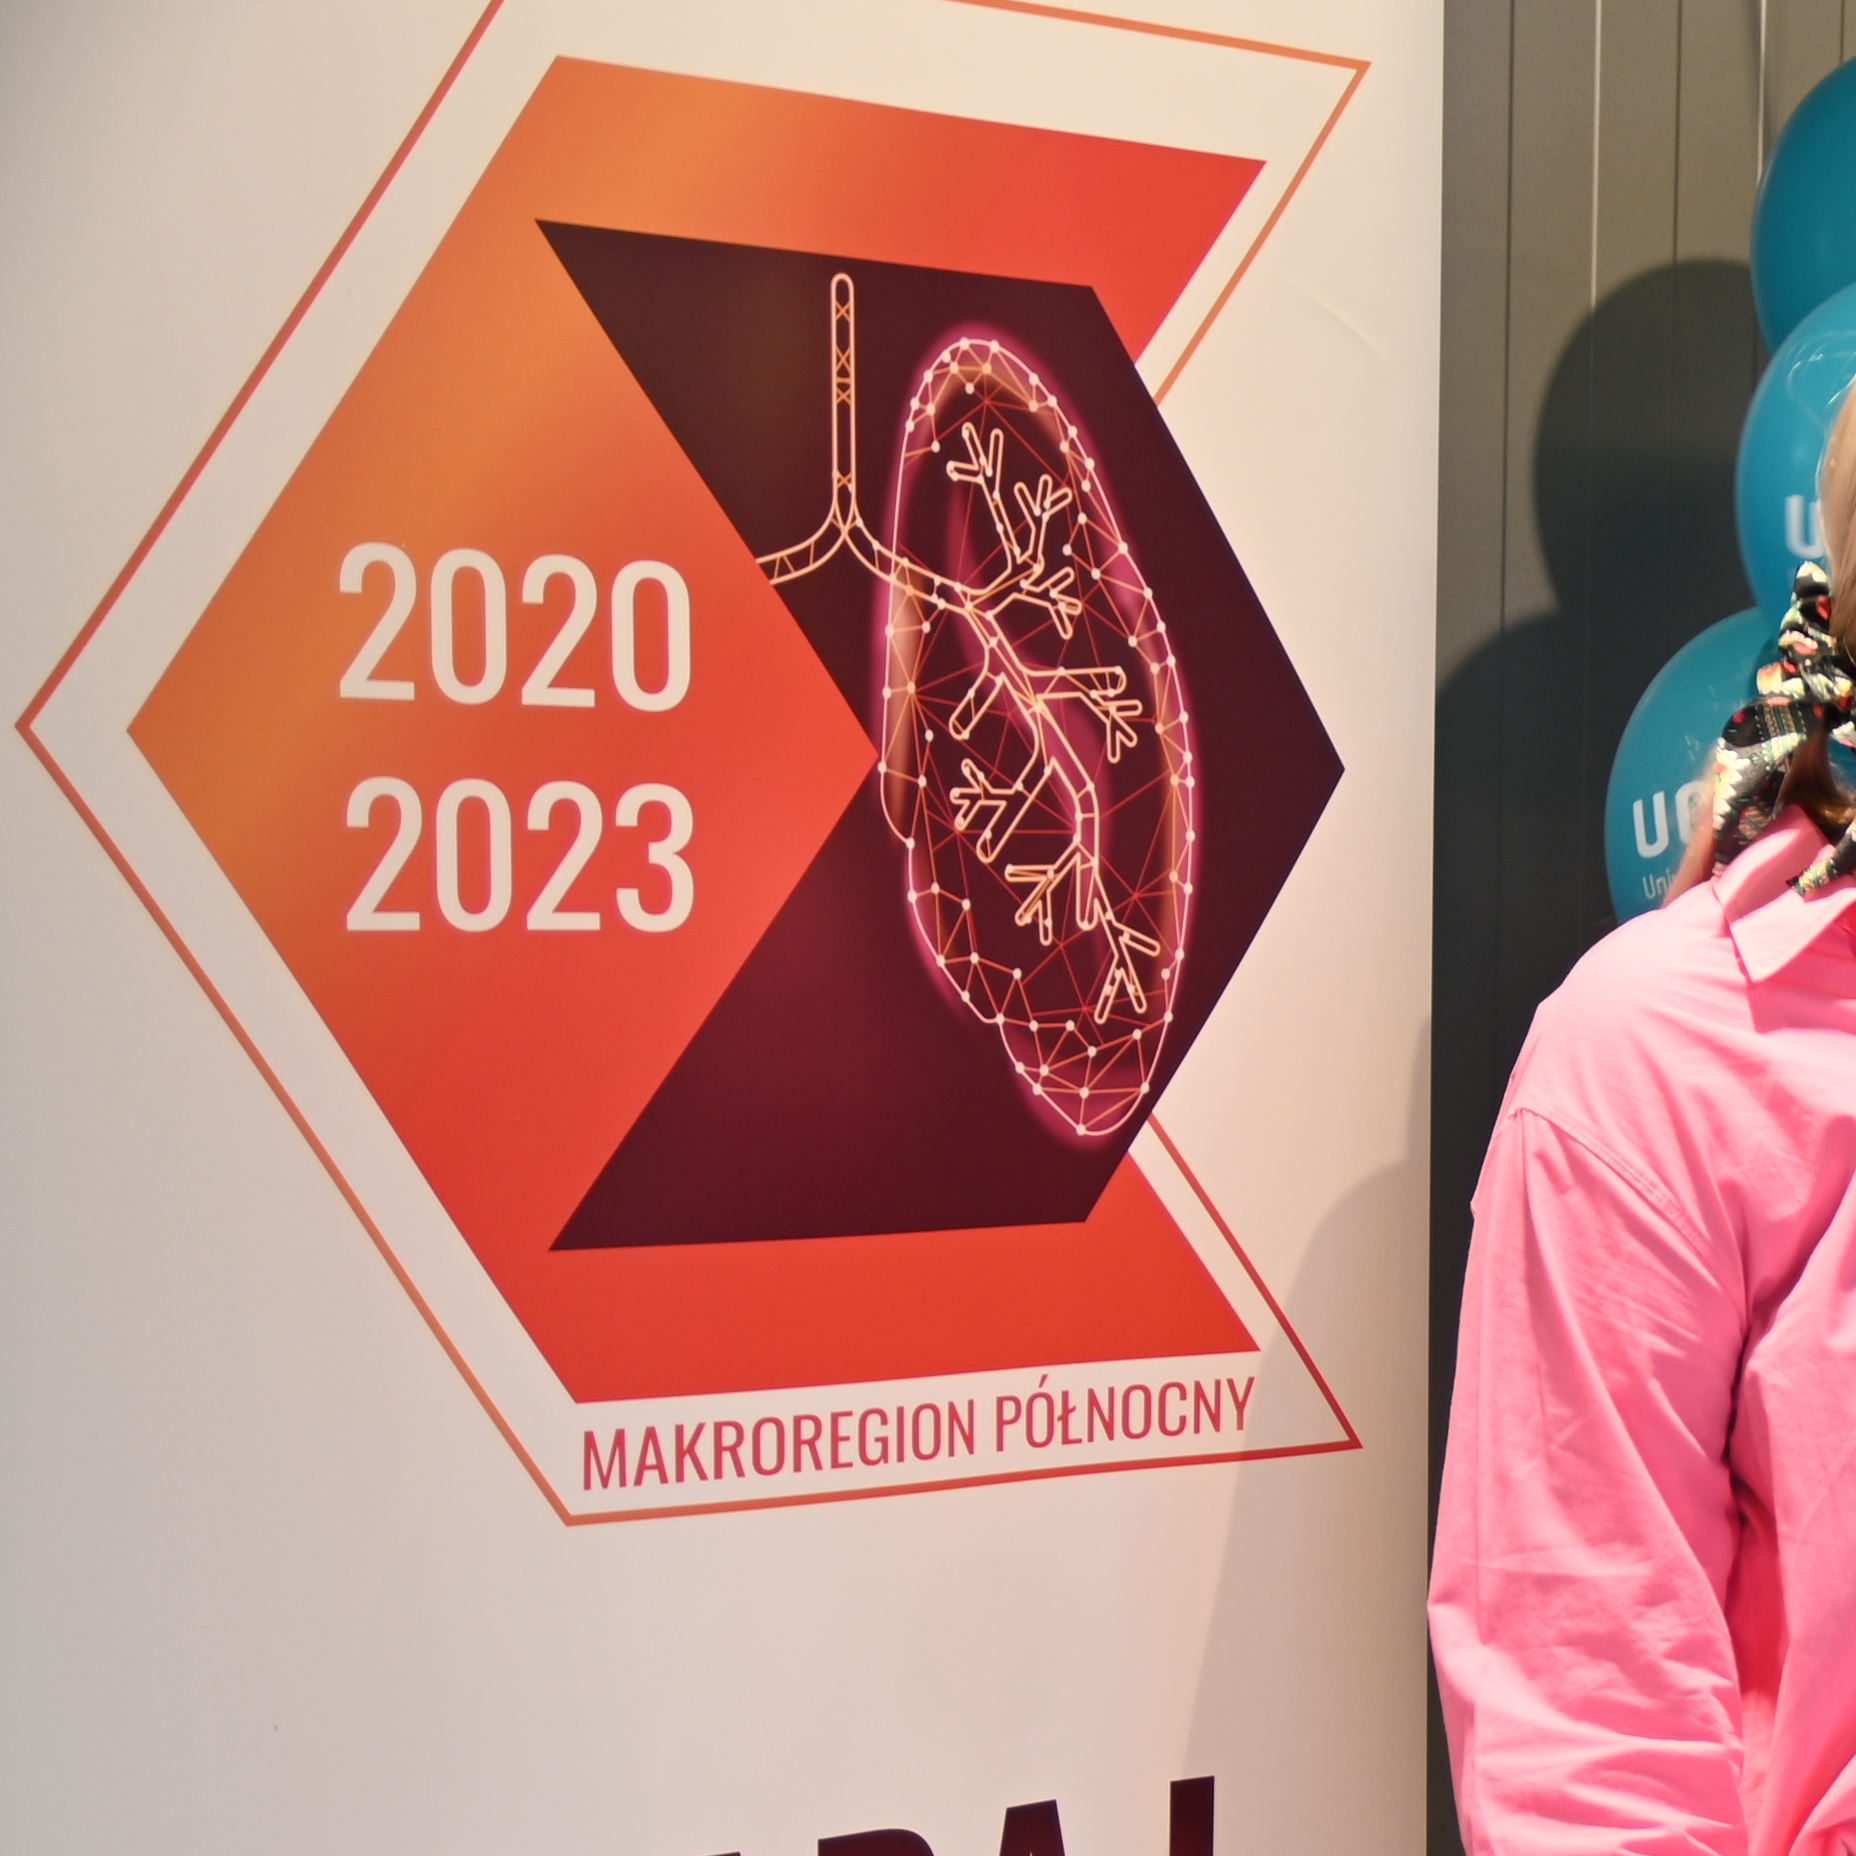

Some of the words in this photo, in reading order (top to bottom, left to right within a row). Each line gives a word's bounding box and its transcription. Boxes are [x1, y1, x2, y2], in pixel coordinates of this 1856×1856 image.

[337, 541, 691, 714] 2020
[344, 777, 694, 936] 2023
[583, 1398, 976, 1491] MAKROREGION
[996, 1374, 1256, 1453] PÓŁNOCNY
